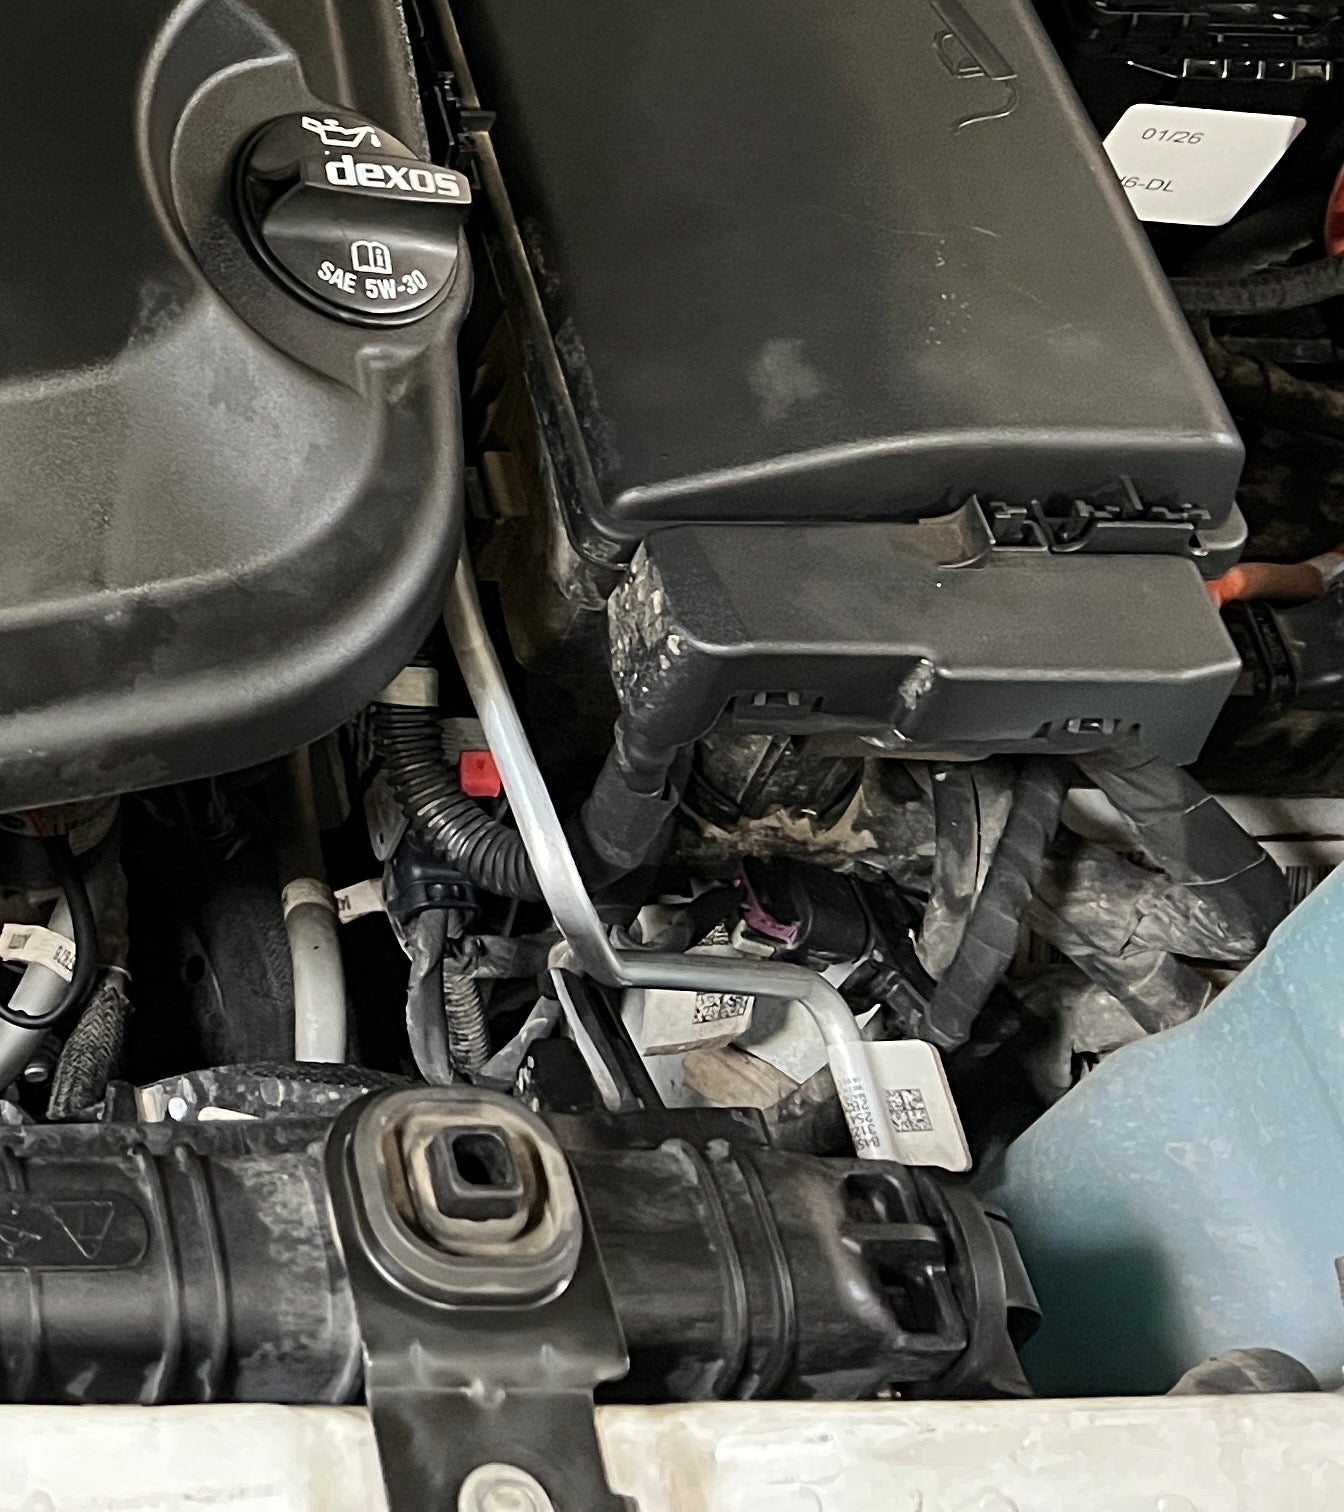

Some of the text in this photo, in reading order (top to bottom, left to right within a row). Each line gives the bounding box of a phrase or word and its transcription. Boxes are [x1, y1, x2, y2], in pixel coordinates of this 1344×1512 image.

[1141, 127, 1206, 145] 01/26
[324, 154, 460, 197] dexos
[317, 259, 429, 301] SAE 5W-30
